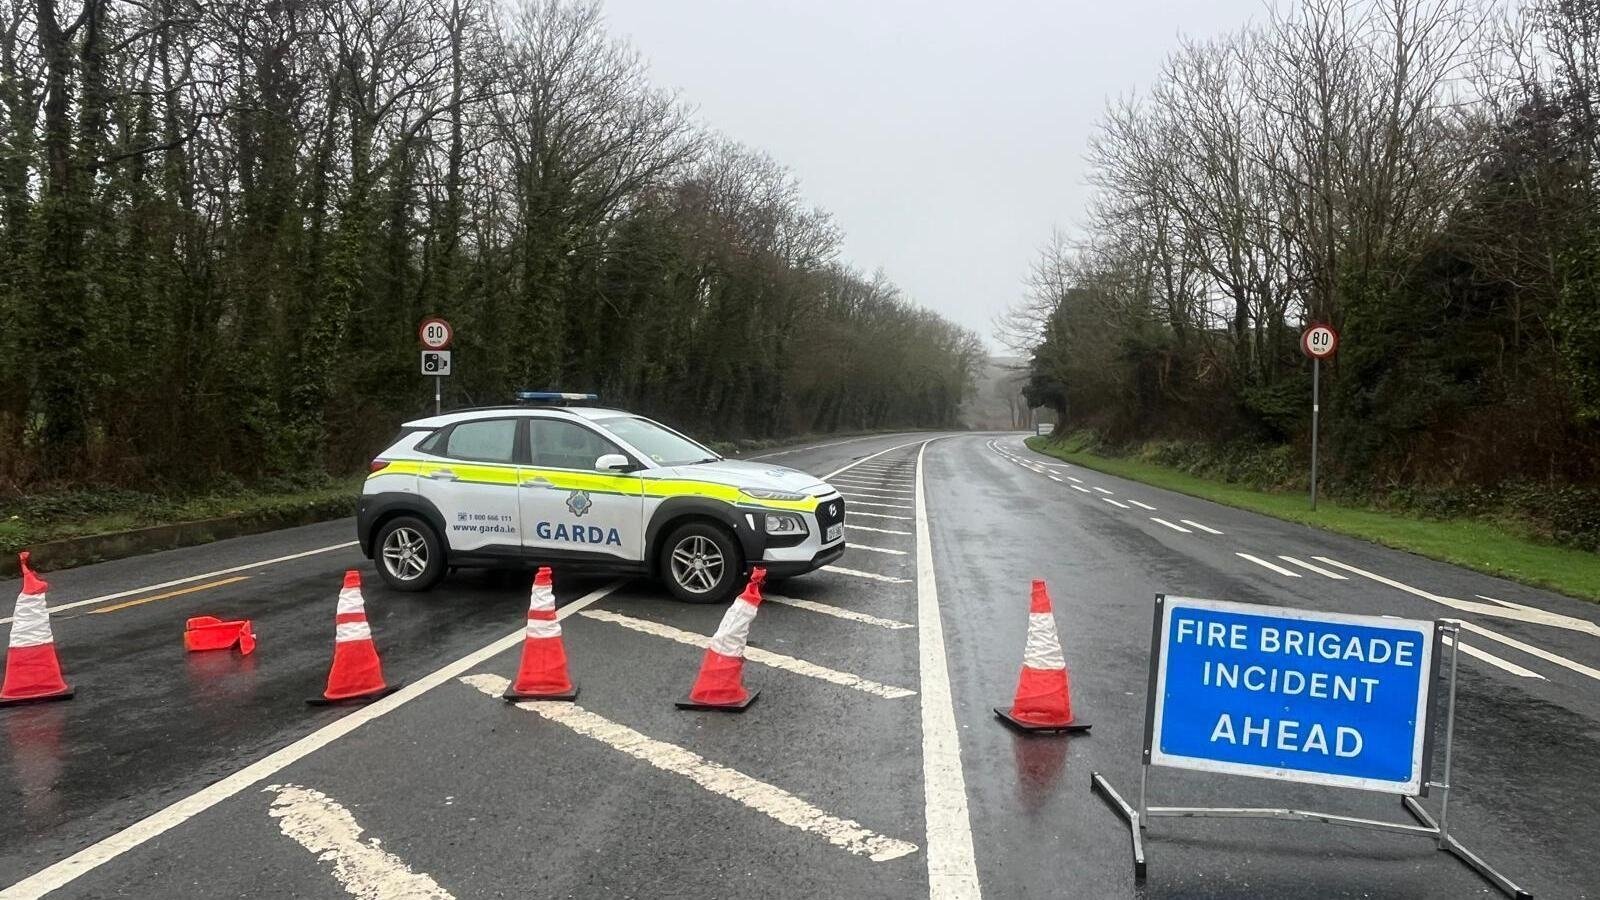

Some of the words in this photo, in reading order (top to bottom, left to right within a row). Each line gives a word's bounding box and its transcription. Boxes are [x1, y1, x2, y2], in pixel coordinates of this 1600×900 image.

[428, 326, 442, 338] 80
[1313, 332, 1328, 345] 80
[453, 524, 516, 534] www.garda.ie
[536, 521, 622, 546] GARDA
[1177, 618, 1248, 650] FIRE
[1260, 627, 1415, 667] BRIGADE
[1203, 661, 1380, 703] INCIDENT
[1210, 713, 1364, 758] AHEAD
